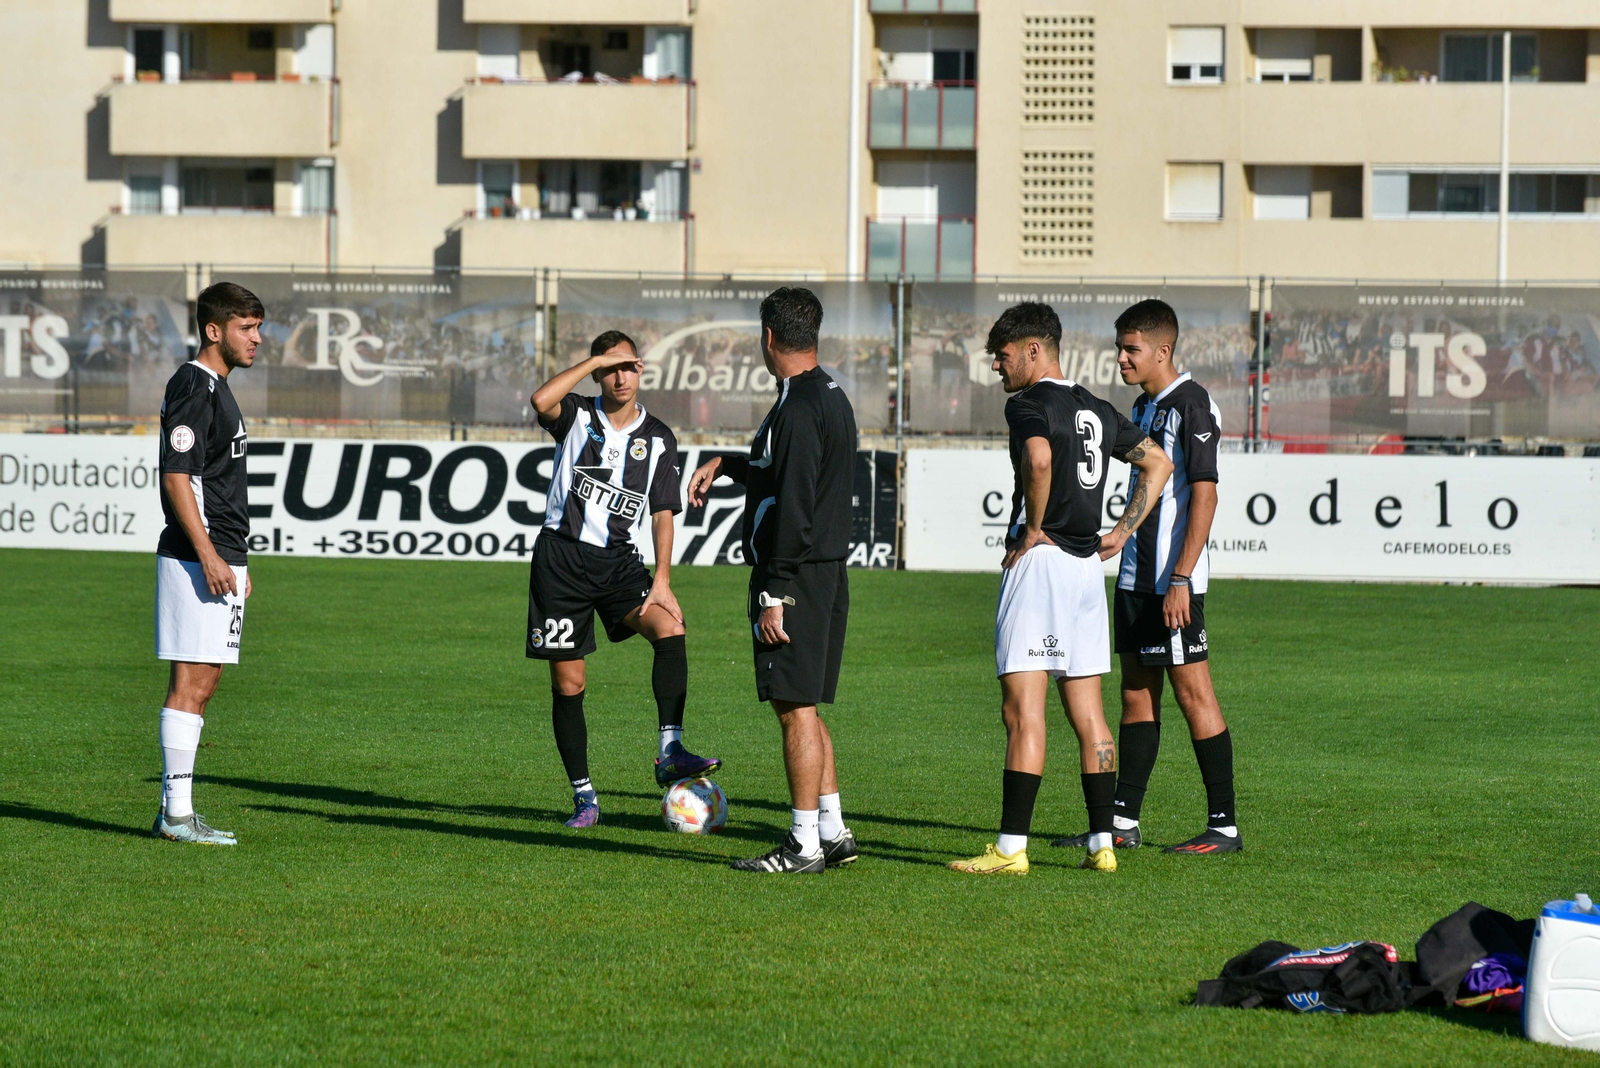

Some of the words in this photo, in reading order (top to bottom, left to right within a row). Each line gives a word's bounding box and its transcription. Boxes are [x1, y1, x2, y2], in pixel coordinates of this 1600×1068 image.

[0, 279, 38, 290] STADIO
[41, 279, 105, 290] MUNICIPAL
[292, 282, 332, 293] NUEVO
[335, 283, 384, 294] ESTADIO
[388, 284, 452, 295] MUNICIPAL
[641, 289, 681, 299] NUEVO
[684, 289, 734, 300] ESTADIO
[997, 292, 1038, 303] NUEVO
[1042, 293, 1092, 303] ESTADIO
[1358, 295, 1399, 306] NUEVO
[1403, 295, 1454, 306] ESTADIO
[1458, 296, 1526, 307] MUNICIPAL
[0, 314, 70, 380] TS
[1074, 408, 1104, 490] 3
[0, 502, 35, 534] de
[50, 502, 136, 536] Cádiz
[248, 528, 294, 553] el:
[313, 531, 537, 558] +3502004
[1224, 540, 1268, 552] LINEA
[1383, 542, 1512, 556] CAFEMODELO.ES
[545, 618, 575, 649] 22
[1028, 649, 1045, 657] Ruiz
